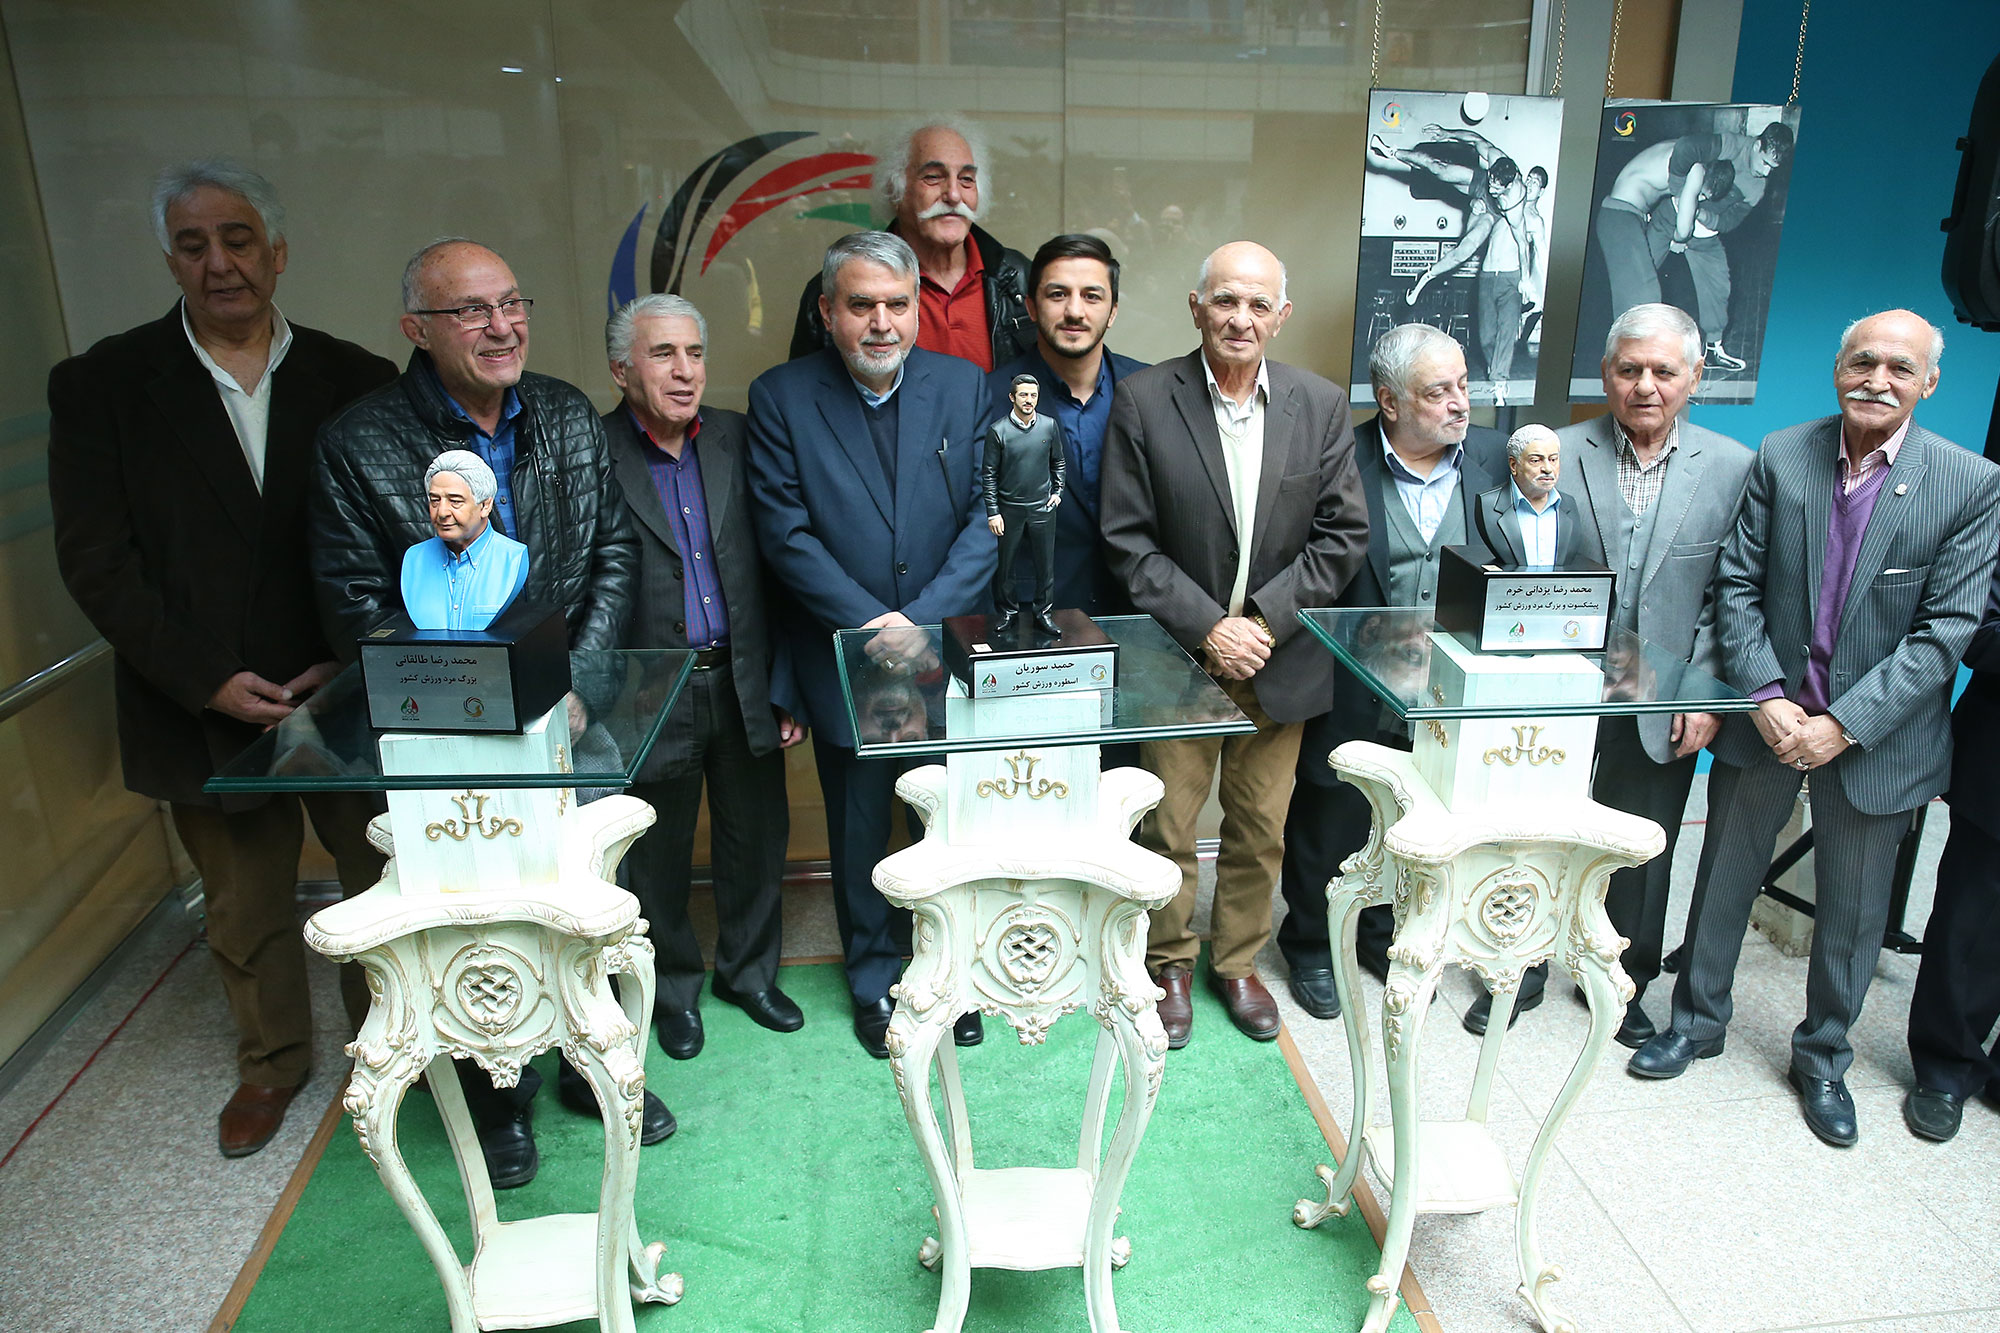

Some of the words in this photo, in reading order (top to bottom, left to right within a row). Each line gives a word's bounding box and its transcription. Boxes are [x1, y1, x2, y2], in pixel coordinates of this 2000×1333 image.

[1506, 585, 1523, 596] خرم
[1525, 585, 1551, 596] یزدانی
[1553, 585, 1568, 595] رضا
[1570, 586, 1592, 594] محمد
[1495, 602, 1513, 611] کشور
[1513, 602, 1532, 611] ورزش
[1533, 603, 1544, 611] مرد
[1545, 602, 1561, 611] بزرگ
[1567, 602, 1599, 610] پیشکسوت
[396, 655, 428, 667] طالقانی
[430, 655, 448, 667] رضا
[451, 656, 477, 665] محمد
[1015, 663, 1049, 675] سوریان
[1051, 662, 1075, 671] حمید
[400, 674, 419, 684] کشور
[421, 675, 442, 684] ورزش
[443, 676, 456, 684] مرد
[458, 675, 477, 685] بزرگ
[1054, 677, 1079, 687] اسطوره
[1012, 681, 1031, 691] کشور
[1032, 680, 1052, 690] ورزش
